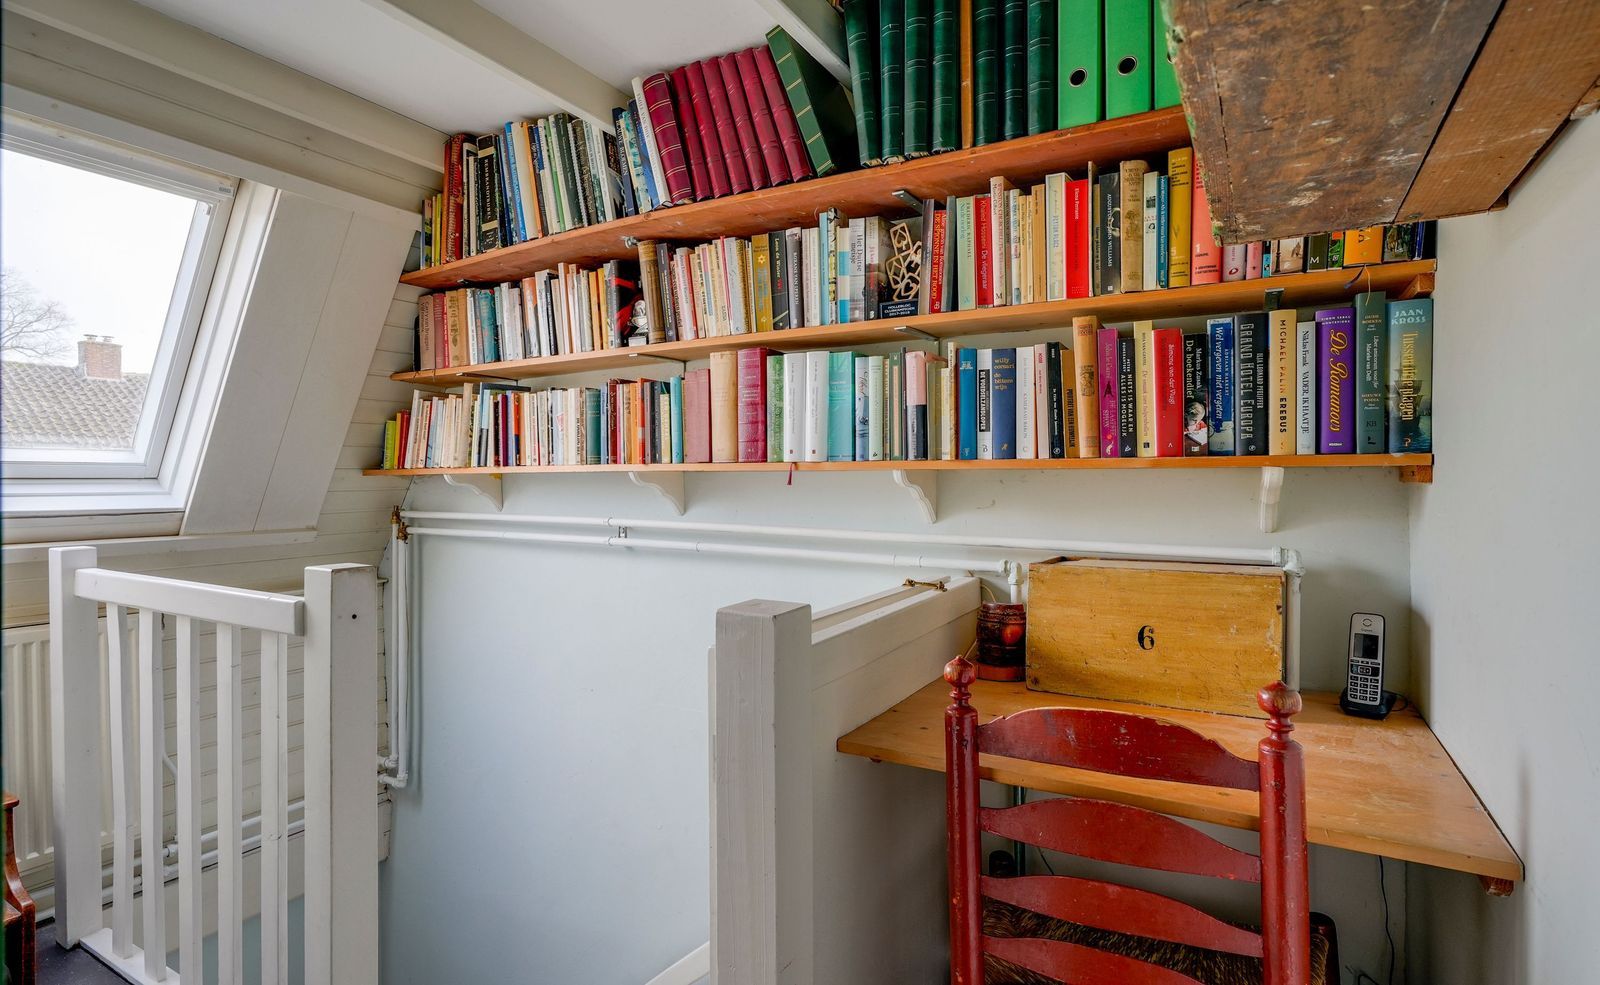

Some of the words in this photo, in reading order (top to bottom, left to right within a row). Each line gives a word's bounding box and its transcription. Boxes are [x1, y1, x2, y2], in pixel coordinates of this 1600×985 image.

[935, 214, 940, 224] DE
[933, 255, 939, 263] IN
[981, 250, 987, 259] De
[1392, 316, 1426, 325] KROSS
[1394, 309, 1423, 318] JAAN
[1186, 340, 1193, 351] De
[1240, 323, 1254, 359] GRAND
[1330, 330, 1348, 355] De
[1402, 331, 1418, 366] Tussen
[1186, 354, 1194, 399] boekendief
[1216, 374, 1224, 388] niet
[1240, 362, 1254, 396] HOTEL
[1402, 367, 1417, 387] drie
[1214, 389, 1224, 419] vergeten
[1328, 358, 1348, 432] Romanovs
[1399, 388, 1418, 420] plagen
[1128, 423, 1133, 432] EN
[1240, 399, 1255, 440] EUROPA
[1137, 625, 1155, 650] 6
